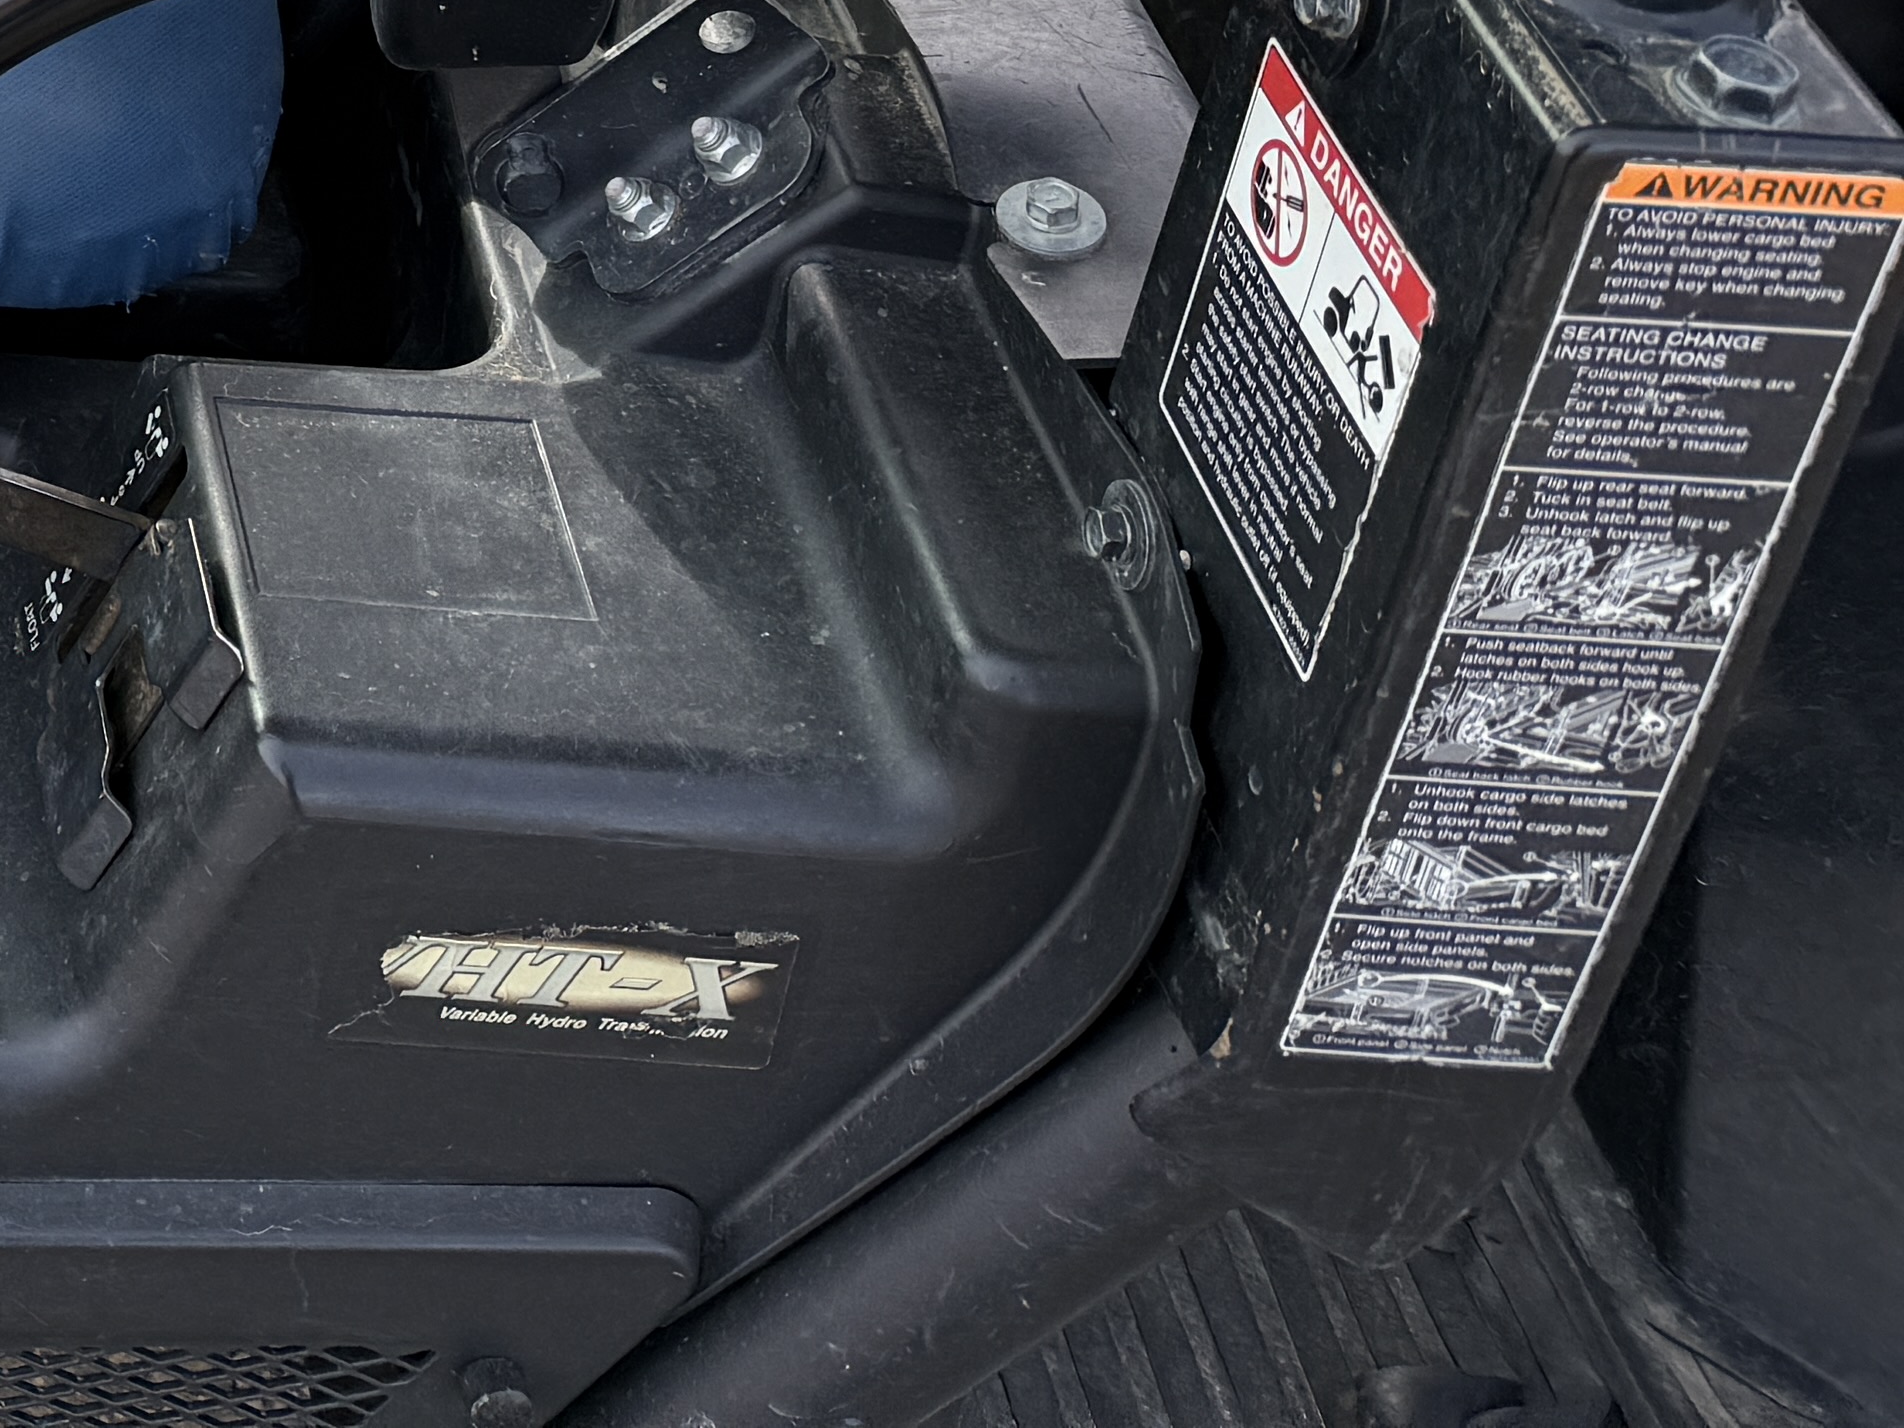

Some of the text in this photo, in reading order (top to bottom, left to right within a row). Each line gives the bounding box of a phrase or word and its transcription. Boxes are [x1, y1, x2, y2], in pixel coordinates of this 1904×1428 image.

[1684, 175, 1884, 208] WARNING
[1311, 132, 1402, 289] DANGER
[1608, 207, 1634, 222] TO
[1636, 209, 1698, 225] AVOID
[1702, 211, 1806, 231] PERSONAL
[1623, 224, 1686, 241] Always
[1691, 228, 1740, 243] lower
[1744, 232, 1796, 249] cargo
[1799, 233, 1836, 249] bed
[1617, 241, 1664, 256] when
[1669, 244, 1751, 264] changing
[1610, 257, 1673, 276] Always
[1678, 262, 1717, 278] stop
[1721, 265, 1782, 281] engine
[1785, 268, 1822, 282] and
[1604, 276, 1845, 303] remove key when changing
[1216, 230, 1323, 420] FROM A MACHINE RUNAWAY:
[1223, 211, 1370, 470] TO AVOID POSSIBLE INJURY OR DEATH
[1561, 325, 1767, 351] SEATING CHANGE
[1554, 344, 1726, 369] INSTRUCTIONS
[1557, 416, 1622, 430] reverse
[1627, 417, 1655, 431] the
[1552, 429, 1748, 453] See operator's manual
[1536, 474, 1568, 491] Flip
[1572, 479, 1594, 493] up
[1598, 481, 1634, 493] rear
[1638, 483, 1676, 496] seat
[1533, 490, 1570, 505] Tuck
[1575, 493, 1591, 506] in
[1596, 496, 1634, 509] seat
[1637, 497, 1672, 511] belt.
[1407, 799, 1429, 810] on
[1432, 799, 1469, 812] both
[1414, 783, 1475, 799] Unhook
[1479, 790, 1527, 804] cargo
[1530, 793, 1564, 805] side
[1568, 794, 1628, 809] latches
[1402, 811, 1432, 826] Flip
[1436, 814, 1480, 828] down
[1484, 817, 1523, 831] front
[1525, 822, 1572, 836] cargo
[1575, 823, 1609, 837] bed
[440, 1006, 517, 1024] Variable
[526, 1012, 587, 1030] Hydro
